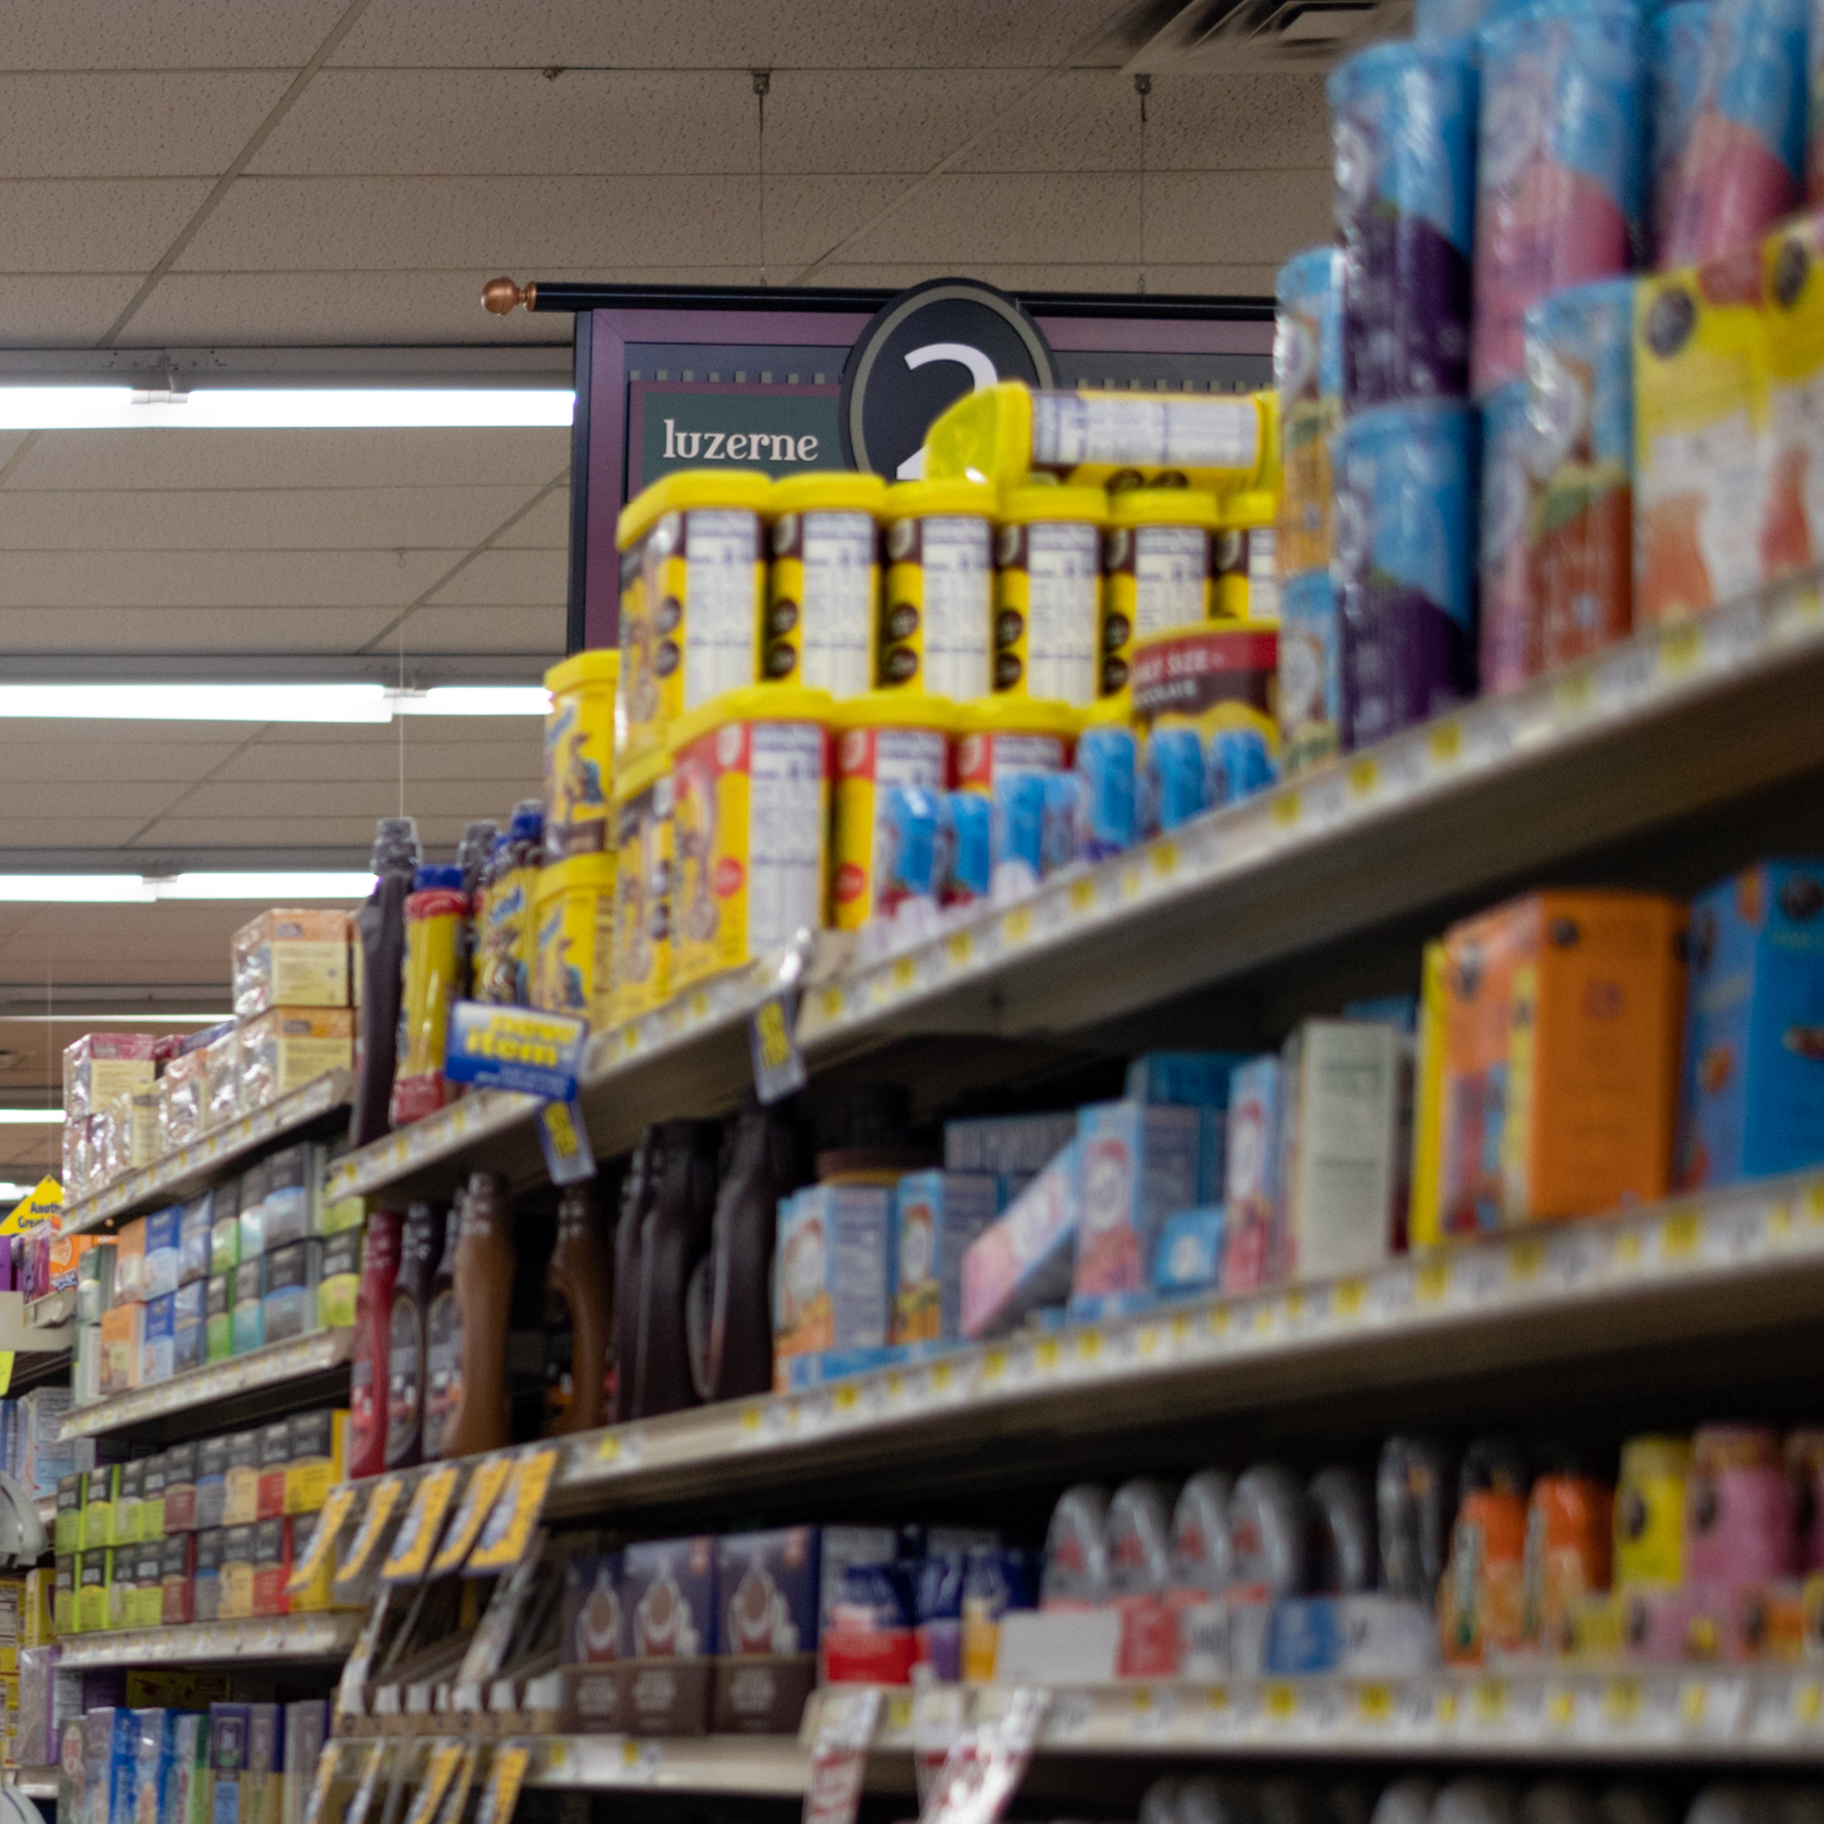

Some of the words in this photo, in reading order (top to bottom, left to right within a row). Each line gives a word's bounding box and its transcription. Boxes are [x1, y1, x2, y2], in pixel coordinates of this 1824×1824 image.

[896, 342, 997, 480] 2
[663, 419, 818, 462] luzerne
[30, 1201, 61, 1213] Anoth
[18, 1216, 48, 1229] Grea
